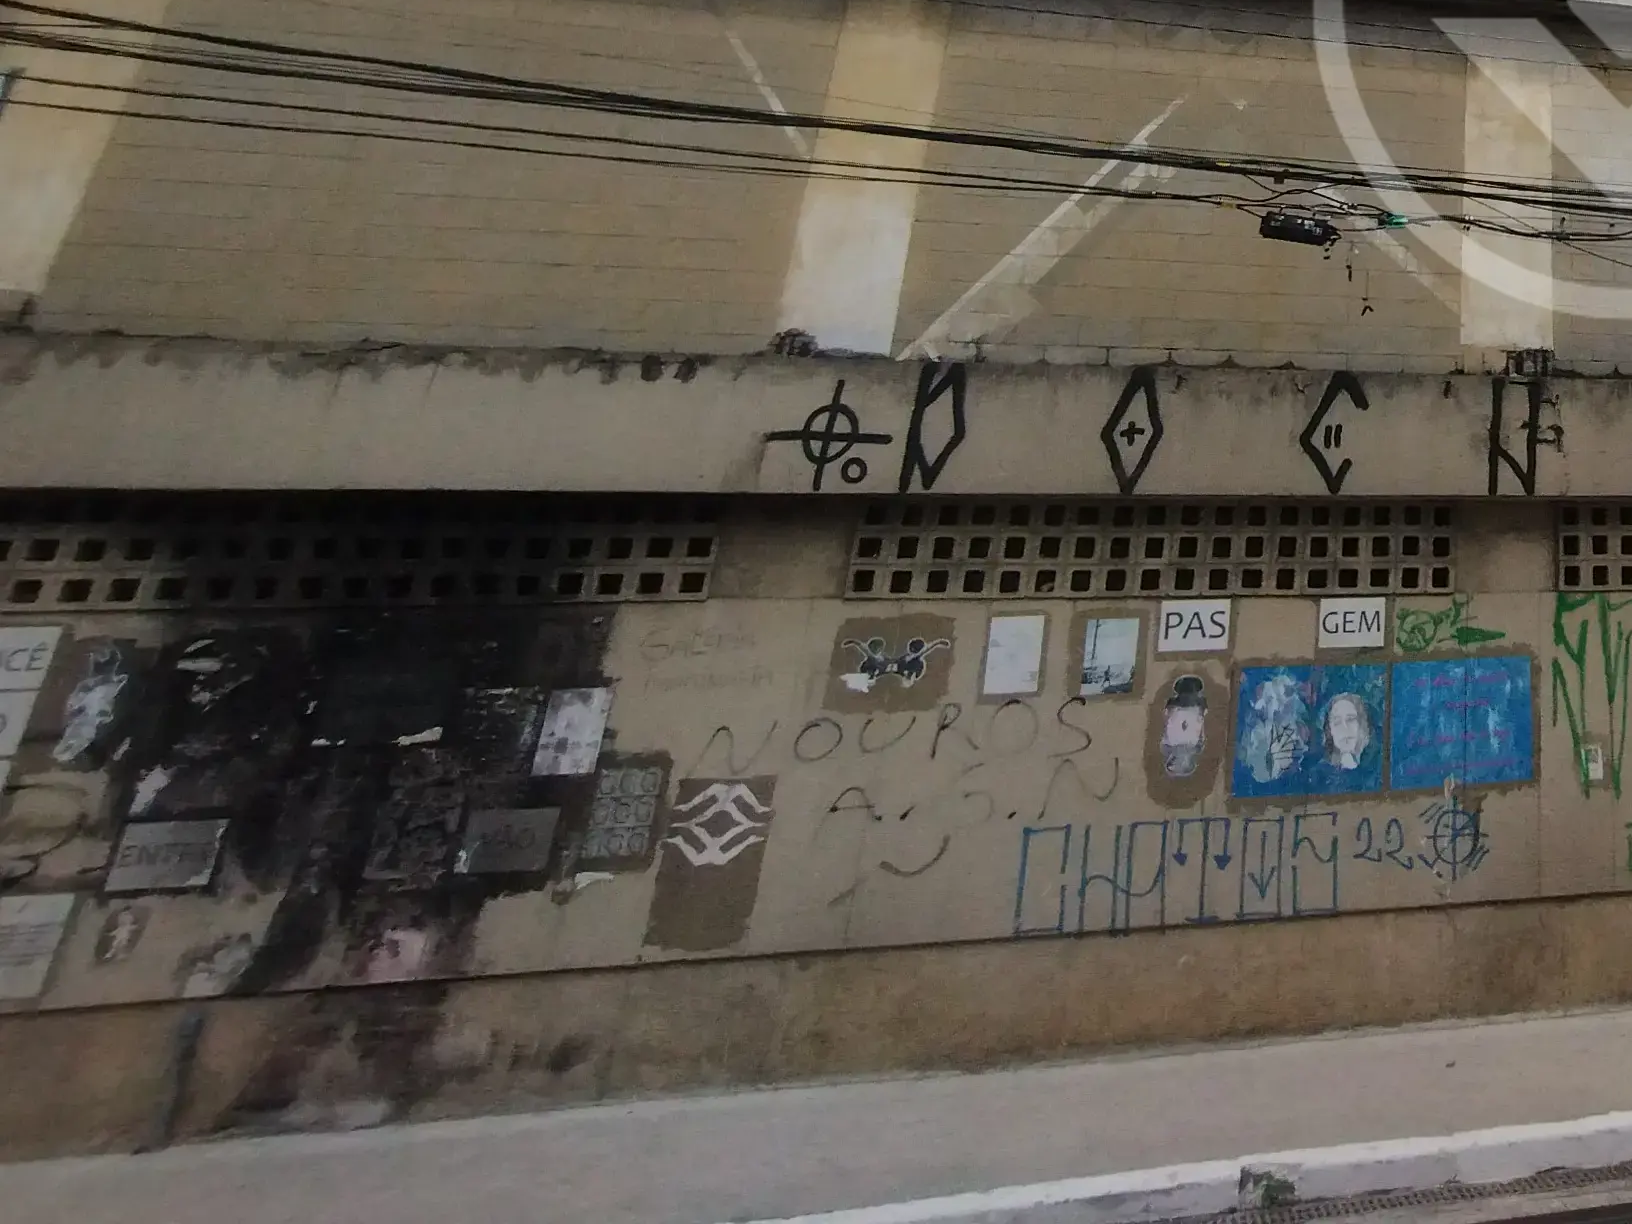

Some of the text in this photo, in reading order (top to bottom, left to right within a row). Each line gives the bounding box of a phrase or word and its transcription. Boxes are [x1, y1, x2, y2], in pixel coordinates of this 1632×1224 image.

[1163, 610, 1382, 640] PAS GEM
[1355, 817, 1414, 870] 22
